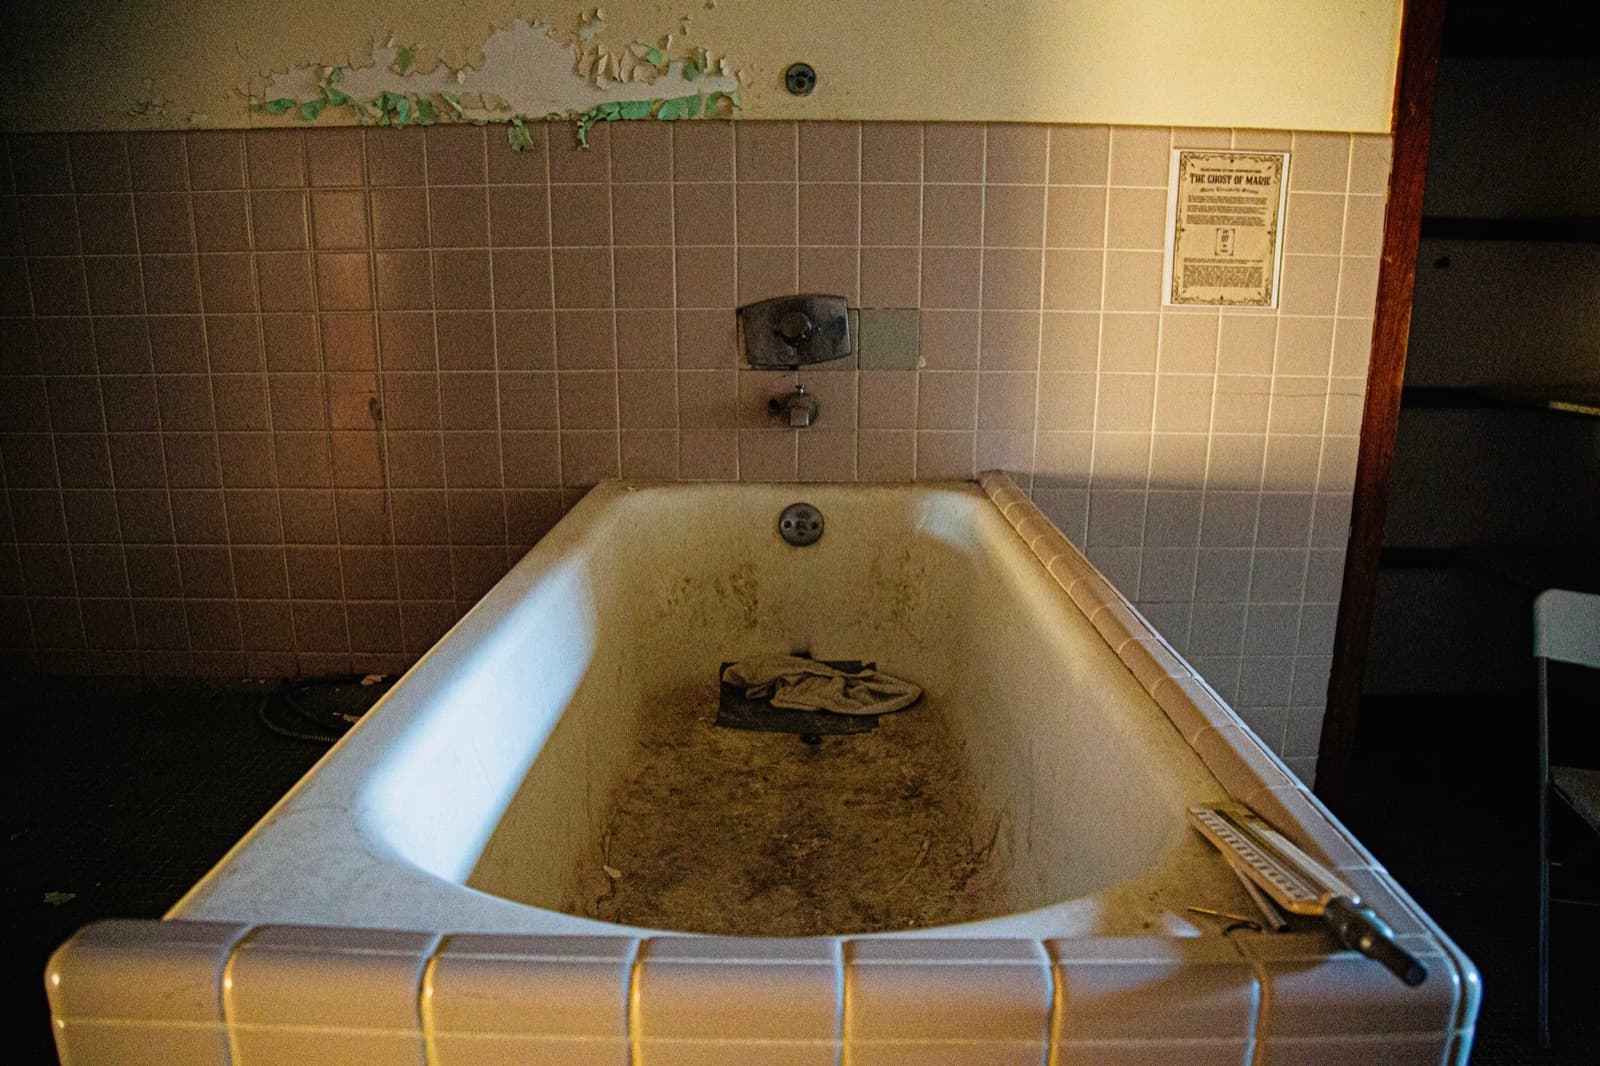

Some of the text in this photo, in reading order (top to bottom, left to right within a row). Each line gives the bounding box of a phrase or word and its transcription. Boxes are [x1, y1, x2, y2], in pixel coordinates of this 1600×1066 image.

[1190, 173, 1271, 186] THE GHOST OF MARIE
